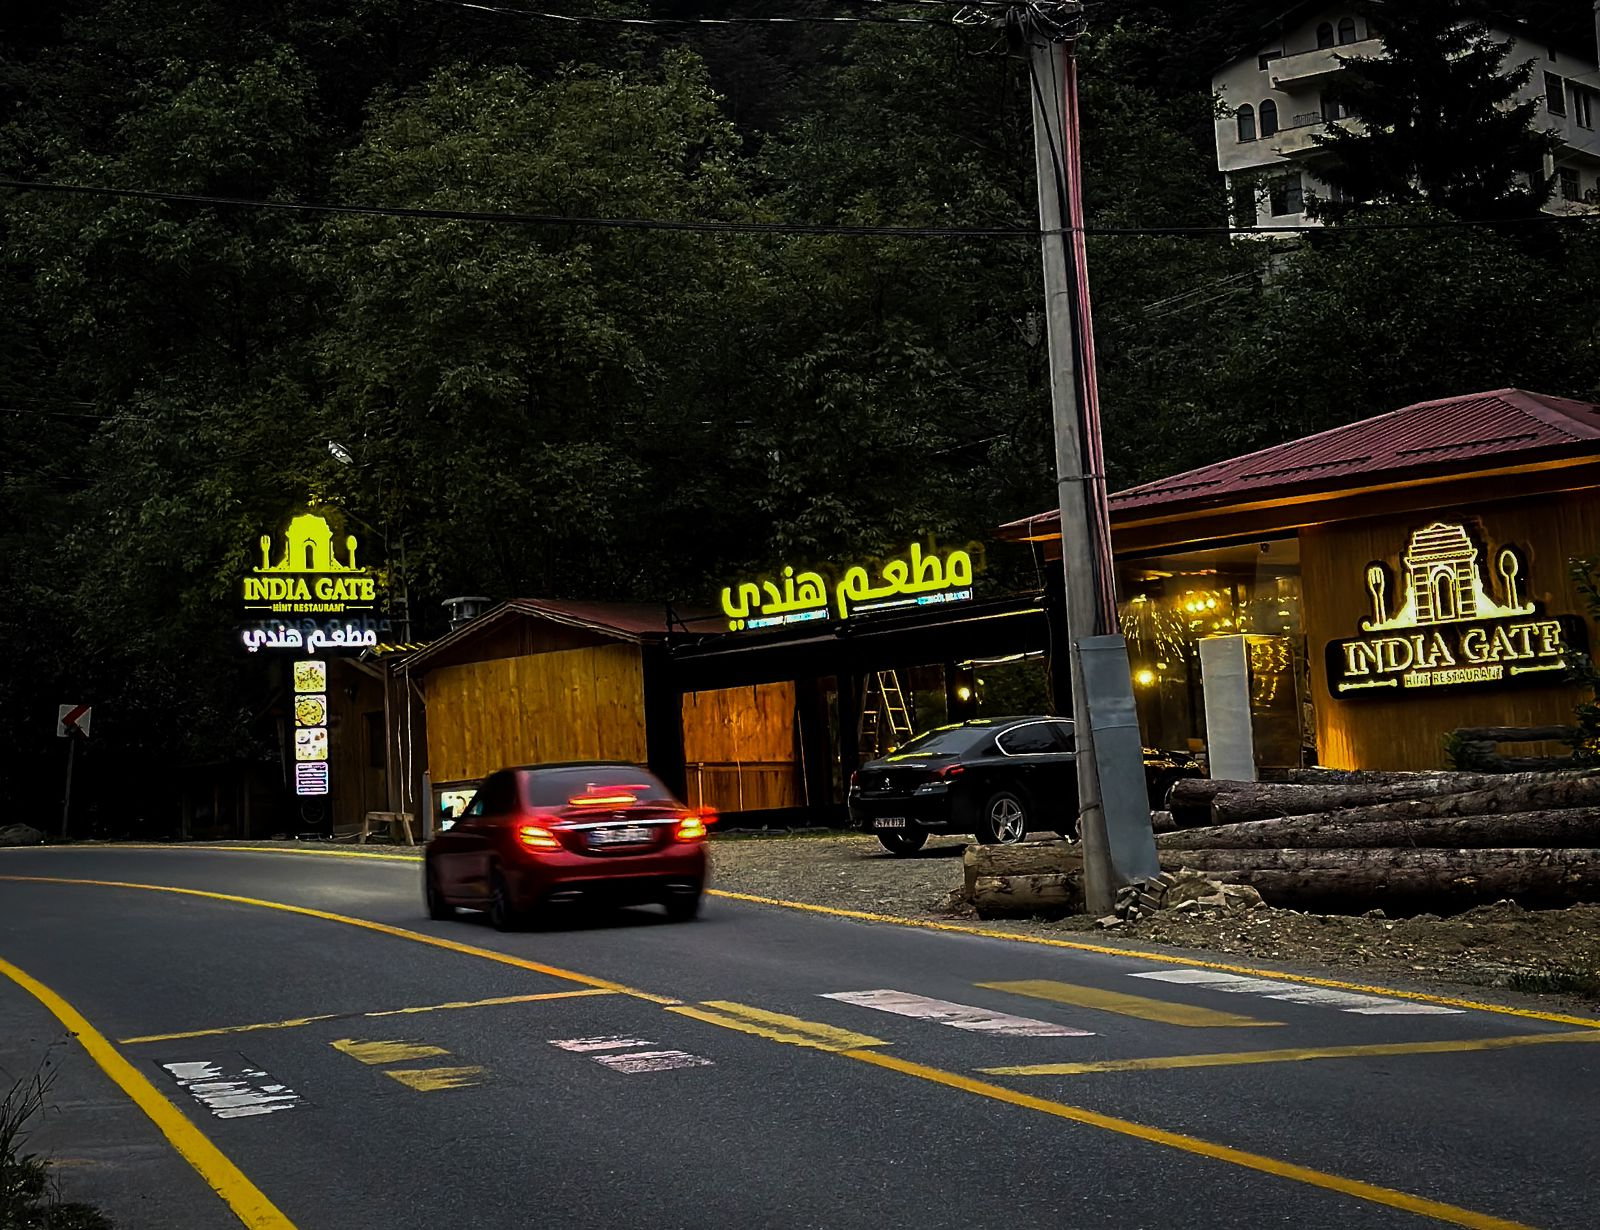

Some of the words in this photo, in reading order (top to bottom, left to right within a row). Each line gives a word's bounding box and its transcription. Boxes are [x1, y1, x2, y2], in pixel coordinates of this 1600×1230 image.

[243, 578, 312, 600] INDIA
[315, 578, 376, 600] GATE
[836, 543, 972, 619] مطعم
[293, 603, 345, 612] RESTAURANT
[722, 566, 827, 632] هندي
[243, 625, 303, 652] هندي
[307, 624, 377, 654] مطعم
[1342, 632, 1456, 676] INDIA
[1463, 620, 1564, 664] GATE
[1432, 665, 1504, 685] RESTAURANT
